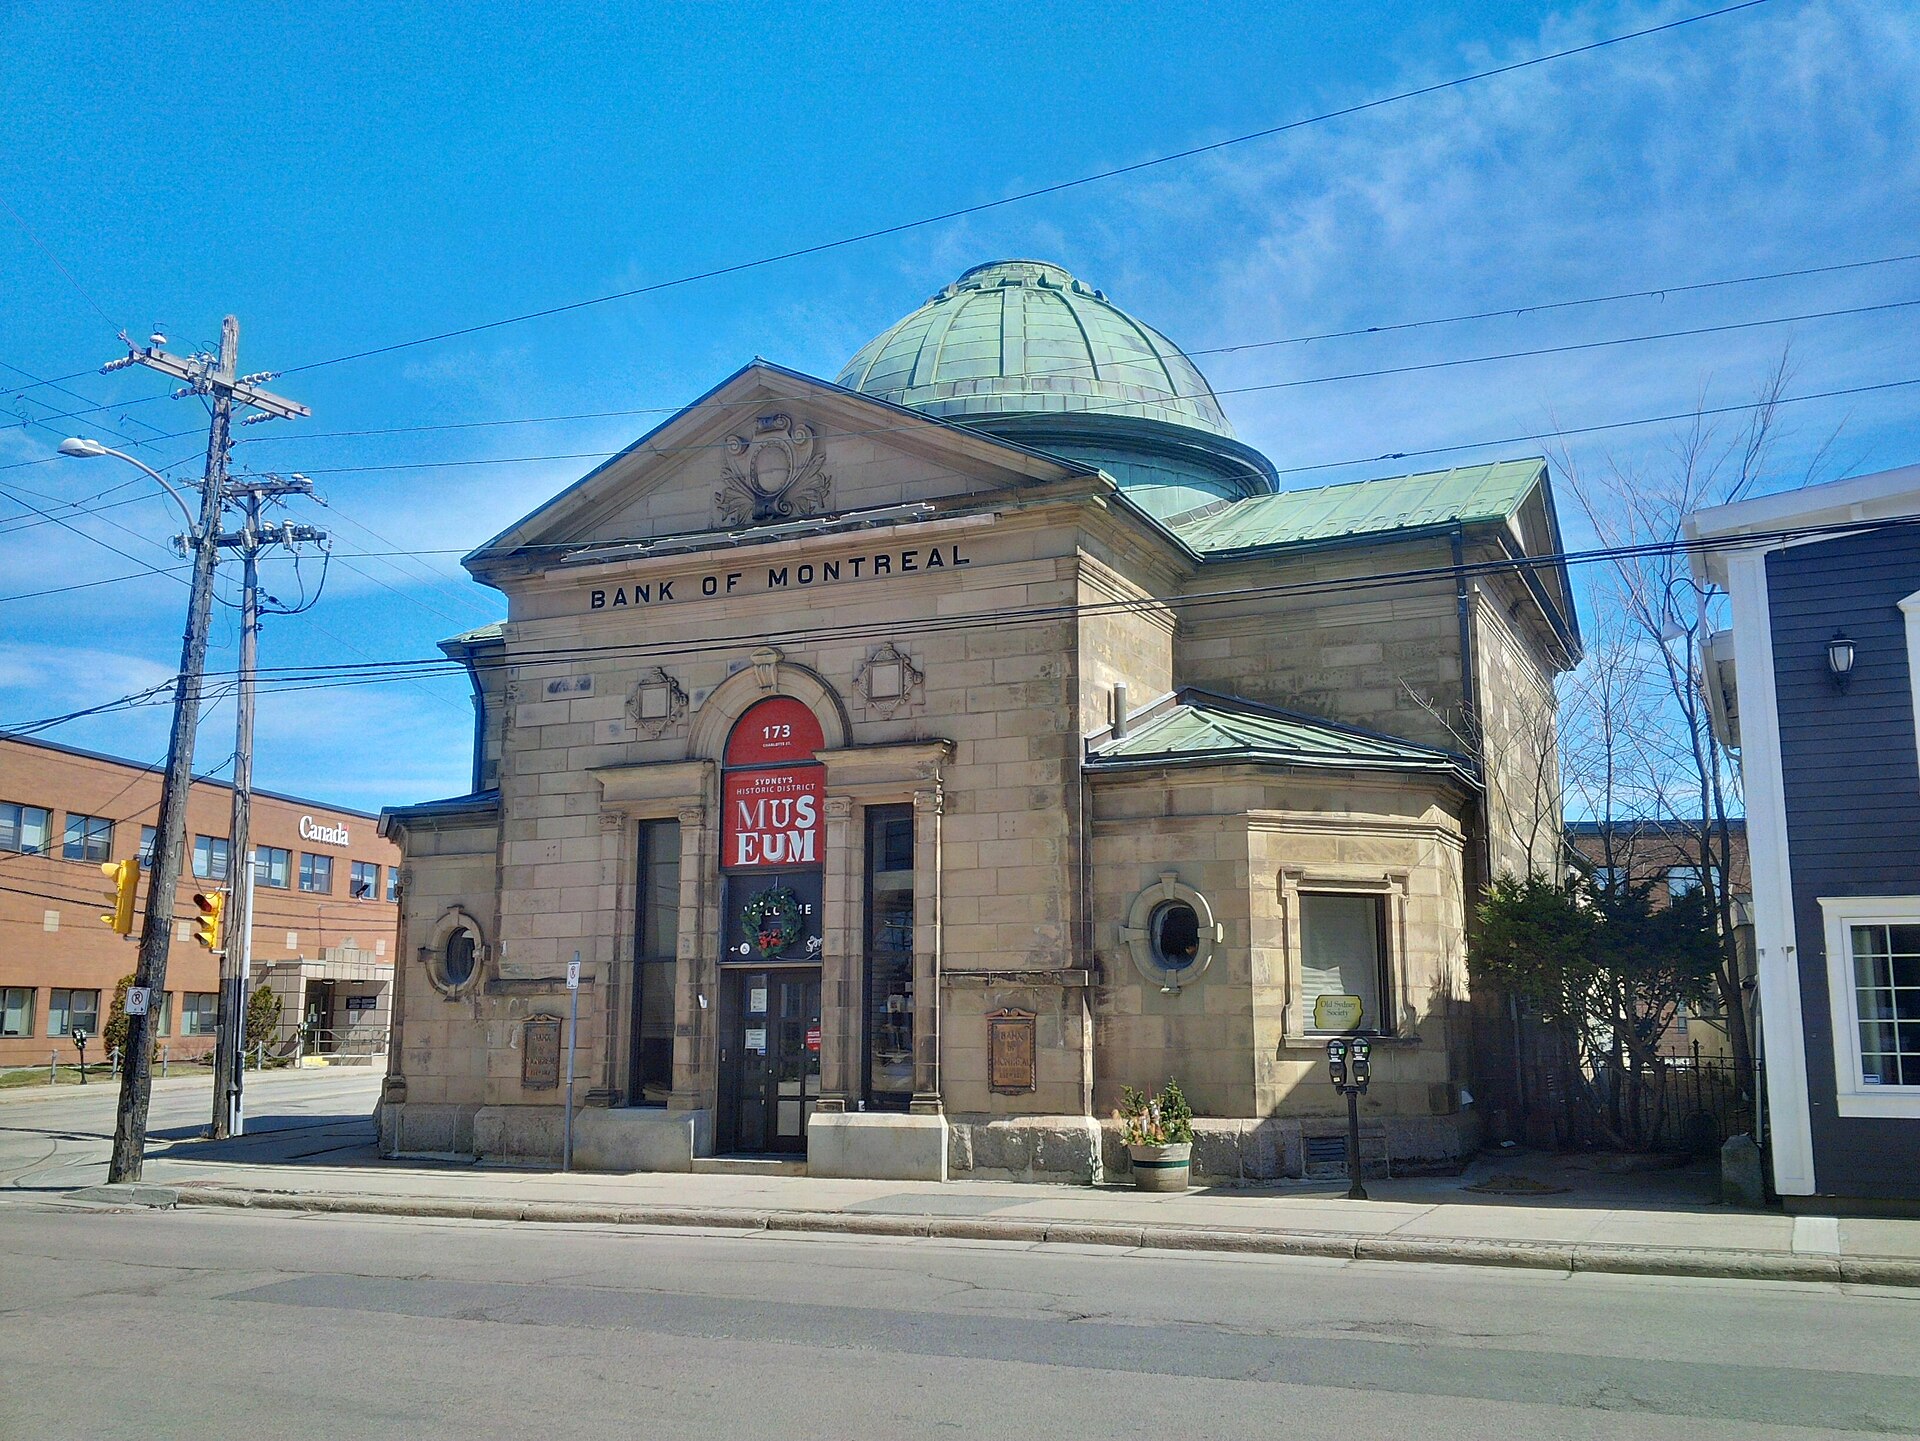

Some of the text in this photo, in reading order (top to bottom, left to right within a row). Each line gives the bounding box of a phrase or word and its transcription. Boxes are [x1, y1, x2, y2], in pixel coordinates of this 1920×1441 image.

[591, 545, 970, 609] BANK OF MONTREAL
[762, 724, 791, 739] 173
[755, 776, 793, 786] SYDNEY'S
[736, 783, 816, 795] HISTORIC DISTRICT
[299, 815, 349, 845] Canada
[1320, 1000, 1357, 1009] Old Sydney
[1327, 1008, 1349, 1017] Society
